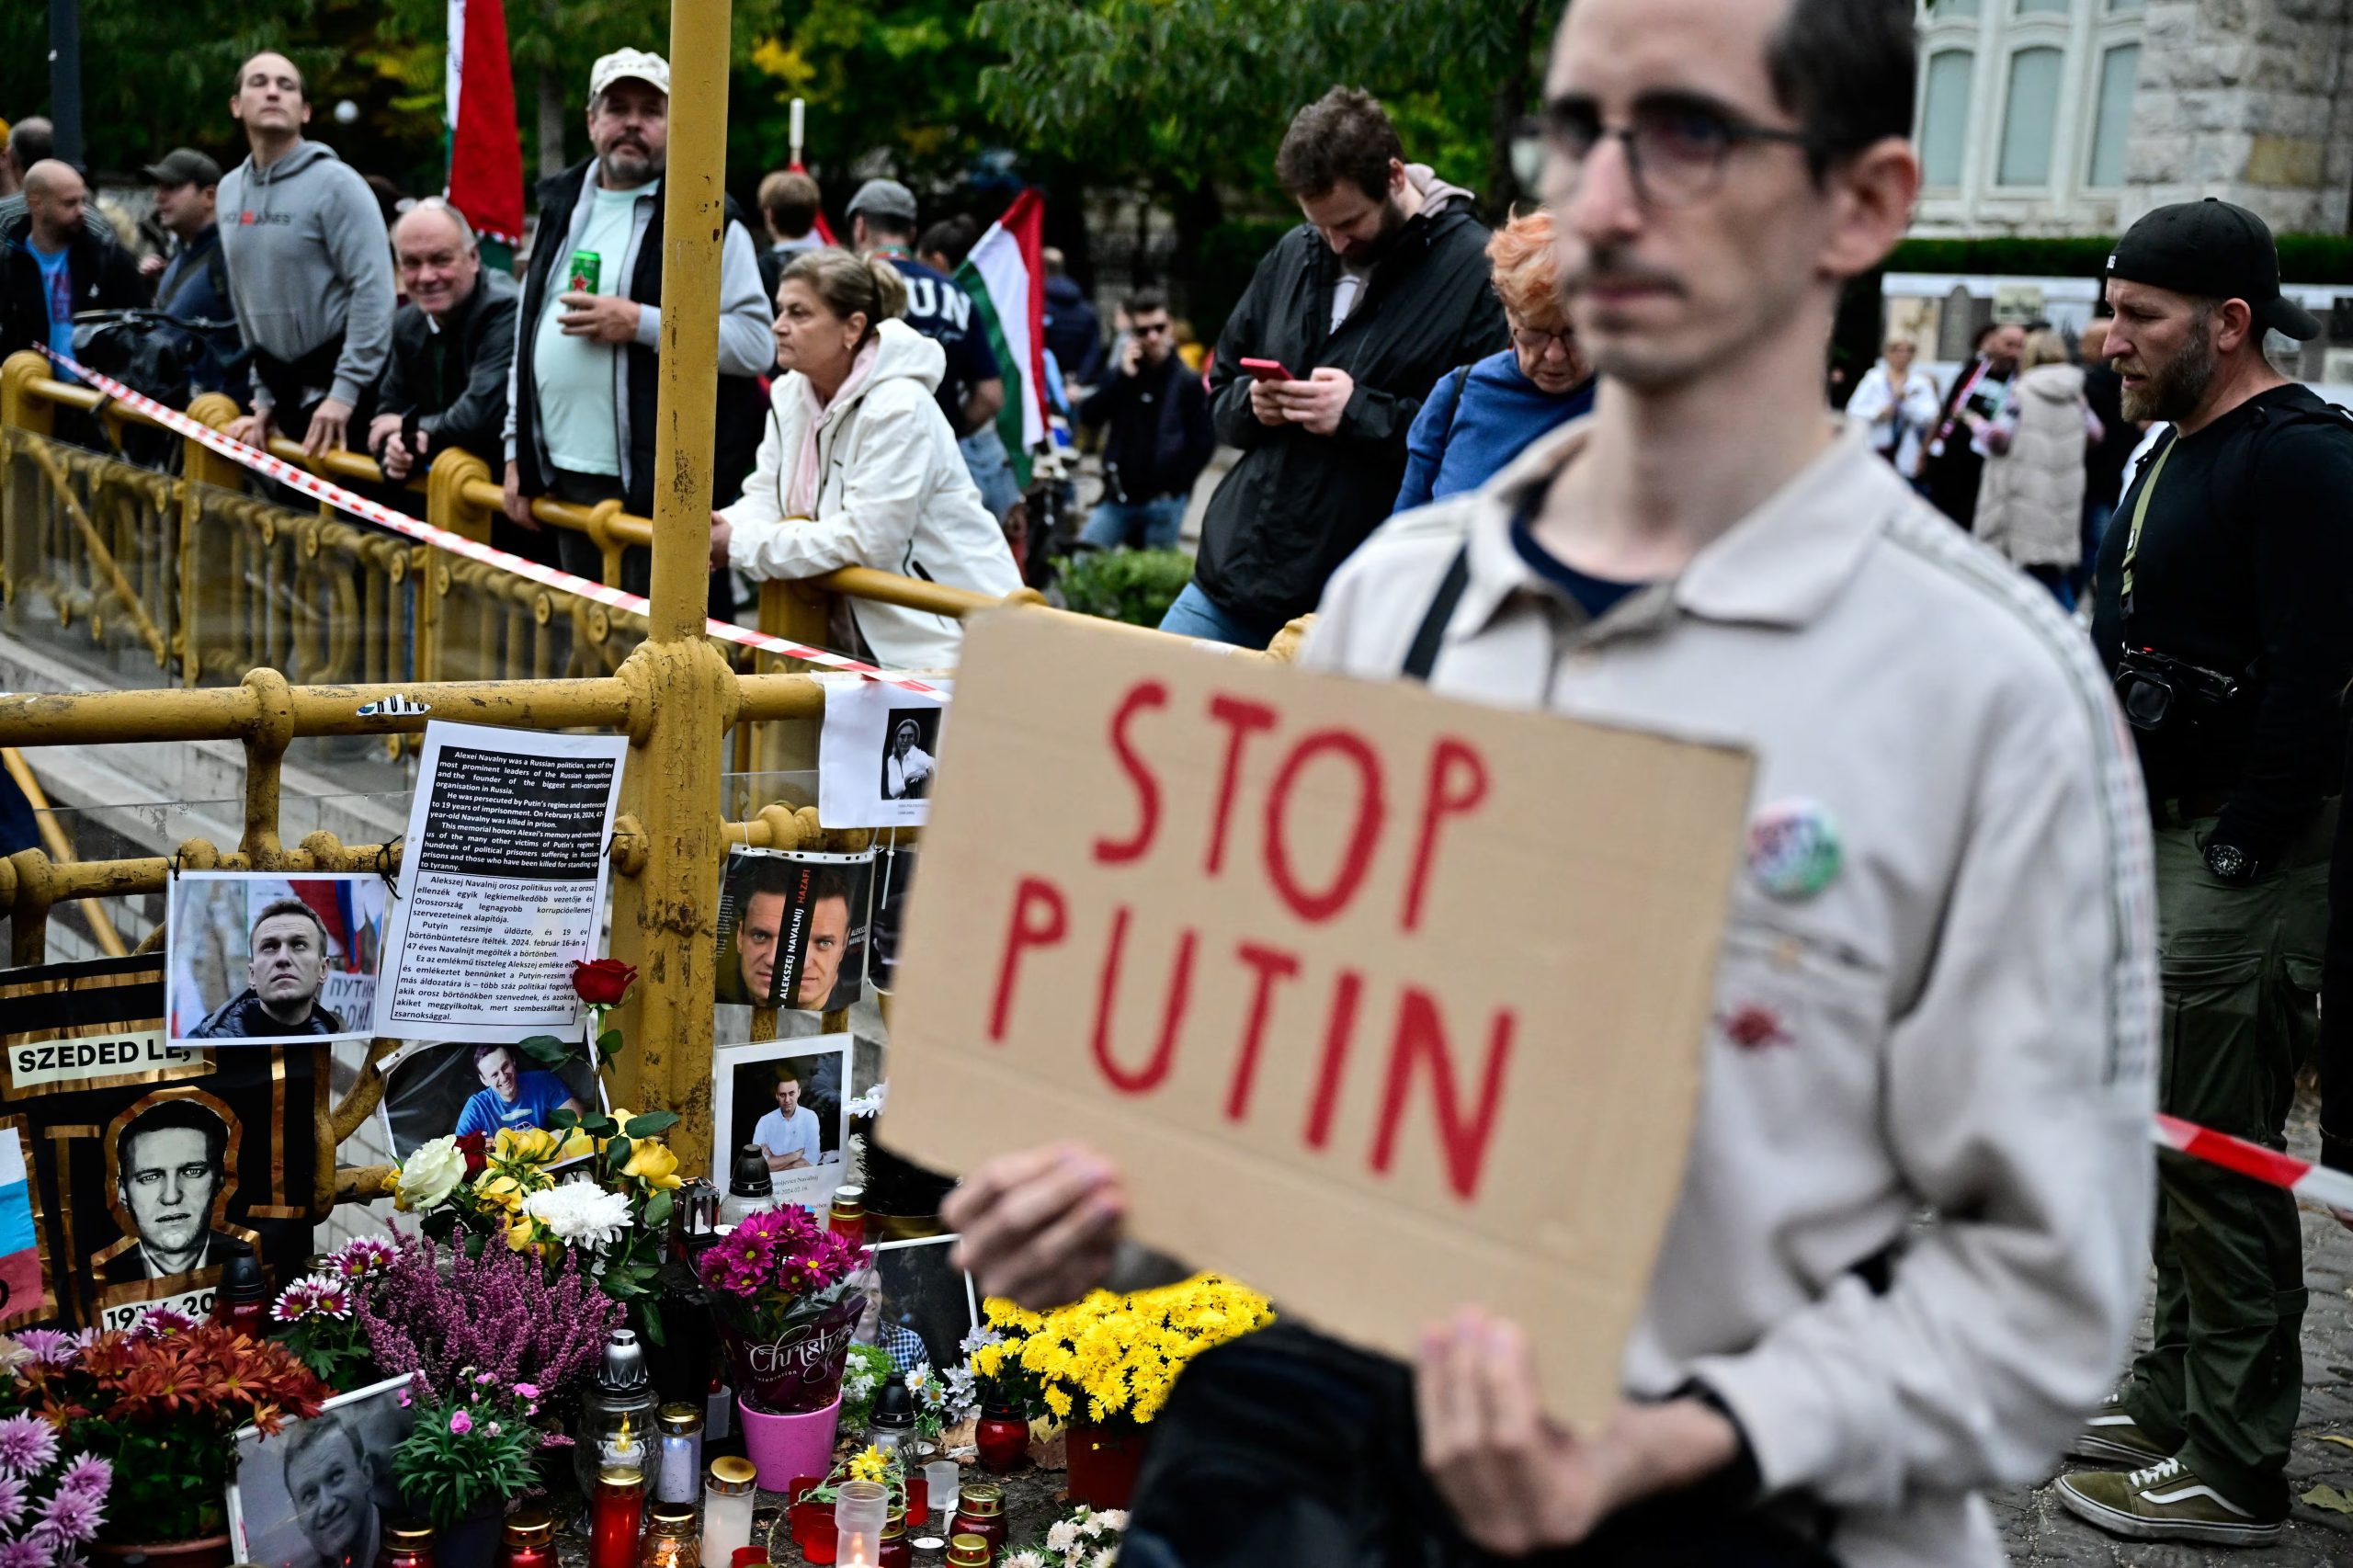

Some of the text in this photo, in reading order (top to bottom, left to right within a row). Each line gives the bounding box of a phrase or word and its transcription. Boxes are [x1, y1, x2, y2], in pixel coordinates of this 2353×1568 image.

[903, 276, 972, 331] UN
[454, 751, 477, 760] Alexei
[478, 754, 507, 764] Navalny
[530, 759, 555, 767] Russian
[462, 764, 500, 773] prominent
[504, 767, 529, 776] leaders
[436, 782, 480, 791] organisation
[490, 786, 514, 794] Russia.
[473, 774, 501, 783] founder
[542, 781, 565, 789] biggest
[473, 796, 513, 804] persecuted
[513, 798, 522, 806] by
[1092, 679, 1490, 933] STOP
[461, 814, 490, 824] Navalny
[481, 805, 532, 816] imprisonment.
[544, 811, 572, 820] February
[492, 827, 516, 835] honors
[424, 840, 458, 850] hundreds
[541, 851, 569, 859] suffering
[430, 862, 460, 871] tyranny.
[430, 876, 463, 887] Alekszej
[465, 879, 497, 890] Navalnij
[417, 886, 450, 896] ellenzék
[457, 891, 478, 899] egyik
[484, 892, 548, 902] legkiemelkedőbb
[554, 896, 581, 904] vezetője
[415, 897, 463, 910] Oroszország
[479, 903, 522, 913] legnagyobb
[413, 910, 509, 924] szervezeteinek alapítója.
[422, 921, 448, 930] Putyin
[460, 925, 492, 934] rezsimje
[504, 927, 533, 936] üldözte,
[780, 869, 811, 999] ALEKSZEJ NAVALNIJ HAZAFI
[409, 931, 479, 943] börtönbüntetésre
[418, 943, 437, 952] éves
[439, 945, 474, 955] Navalnijt
[437, 957, 474, 965] emlékmű
[475, 959, 506, 968] tiszteleg
[508, 961, 537, 969] Alekszej
[416, 967, 460, 976] emlékeztet
[465, 969, 506, 978] bennünket
[420, 978, 462, 987] áldozatára
[443, 990, 492, 999] börtönökben
[396, 999, 421, 1007] akiket
[427, 1002, 483, 1011] meggyilkoltak,
[394, 1011, 451, 1021] zsarnoksággal.
[987, 875, 1517, 1200] PUTIN
[18, 1041, 139, 1073] SZEDED
